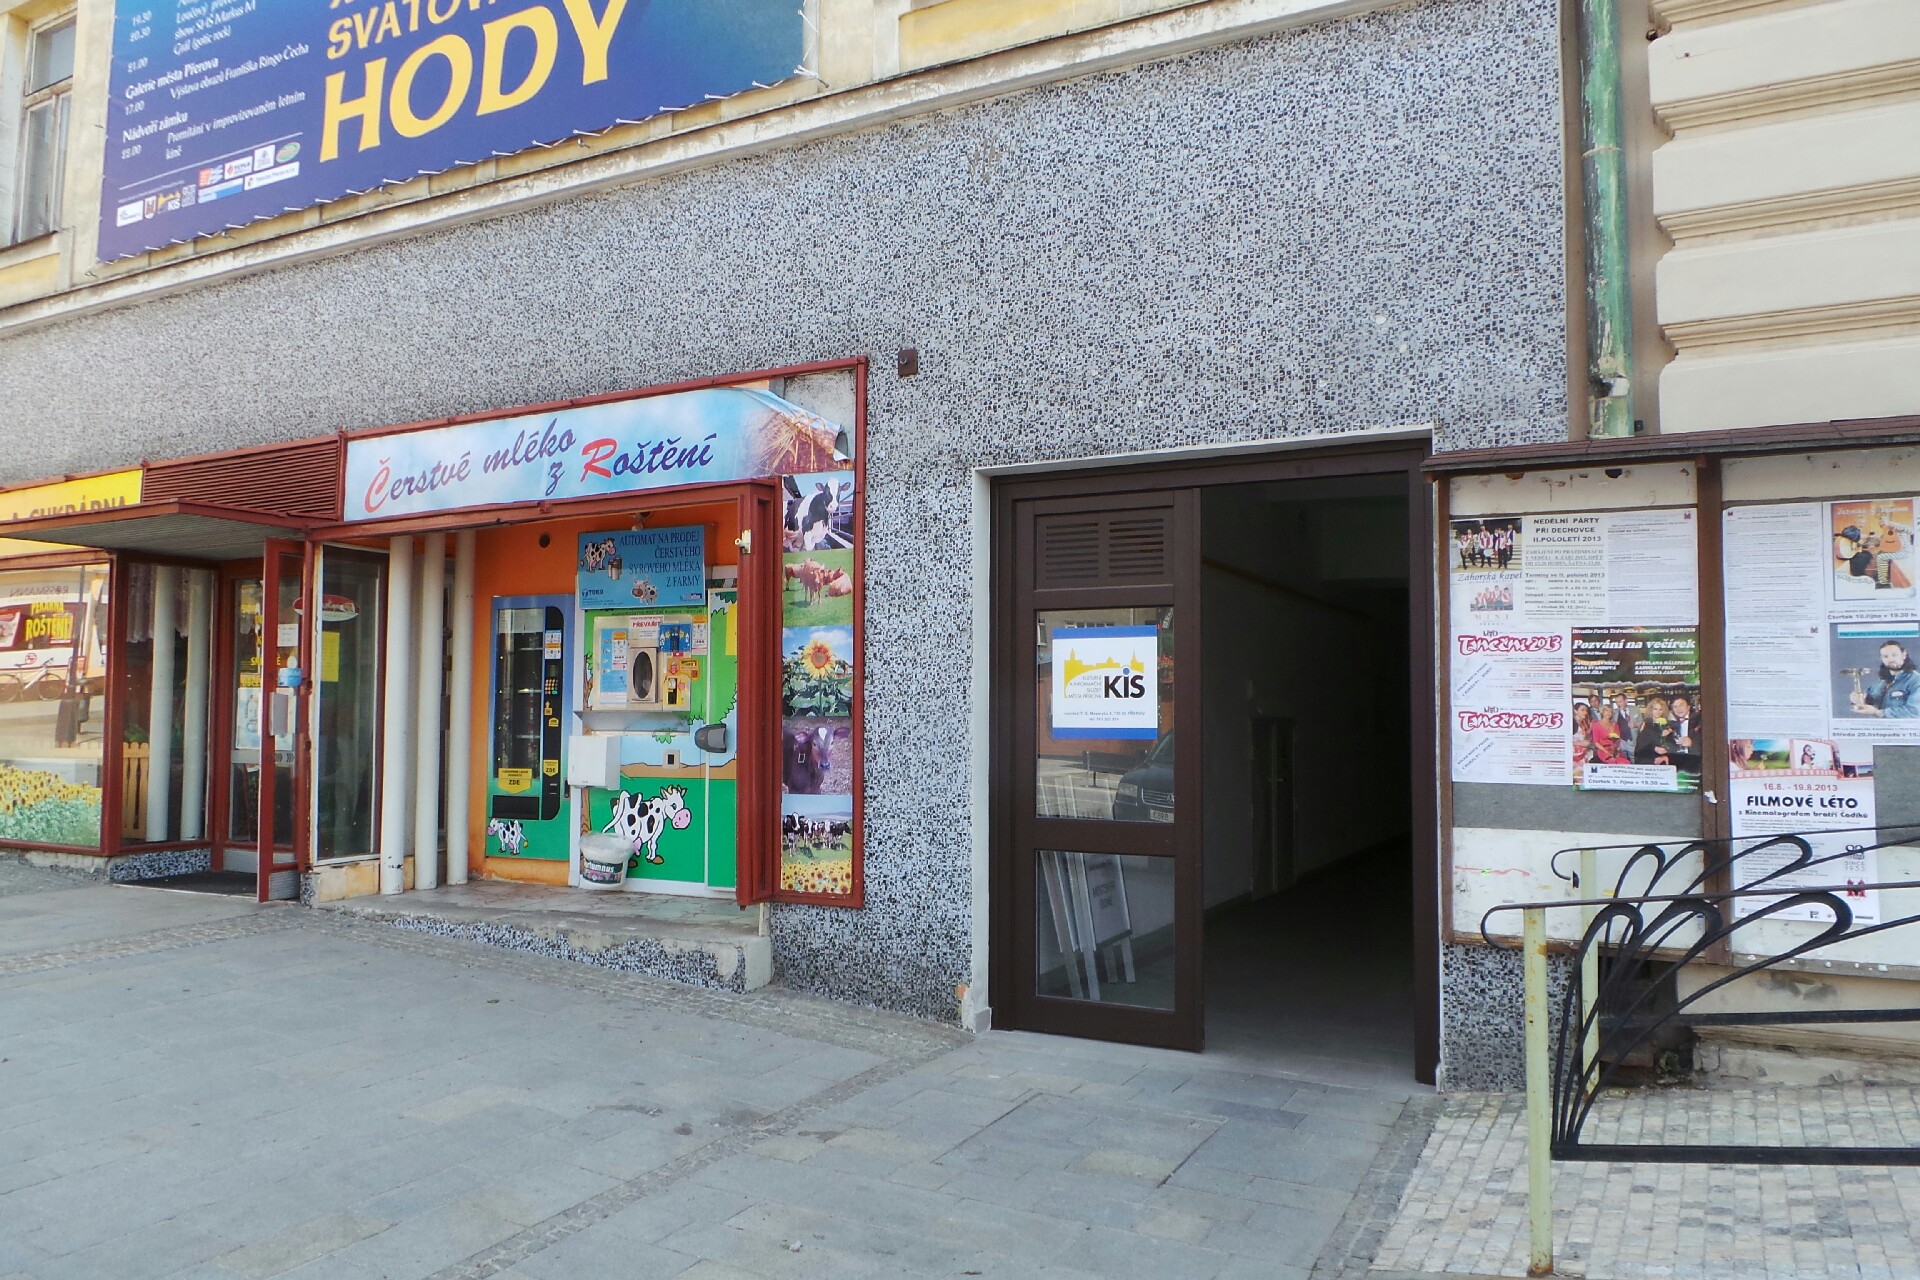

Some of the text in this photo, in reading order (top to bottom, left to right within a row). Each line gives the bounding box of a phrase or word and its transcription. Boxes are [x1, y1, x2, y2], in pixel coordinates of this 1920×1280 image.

[319, 0, 628, 163] HODY
[364, 417, 577, 513] Čerstvé mléko
[545, 433, 717, 498] z Roštění
[1572, 638, 1696, 649] Pozvání na večírek
[1747, 794, 1858, 808] FILMOVÉ LÉTO
